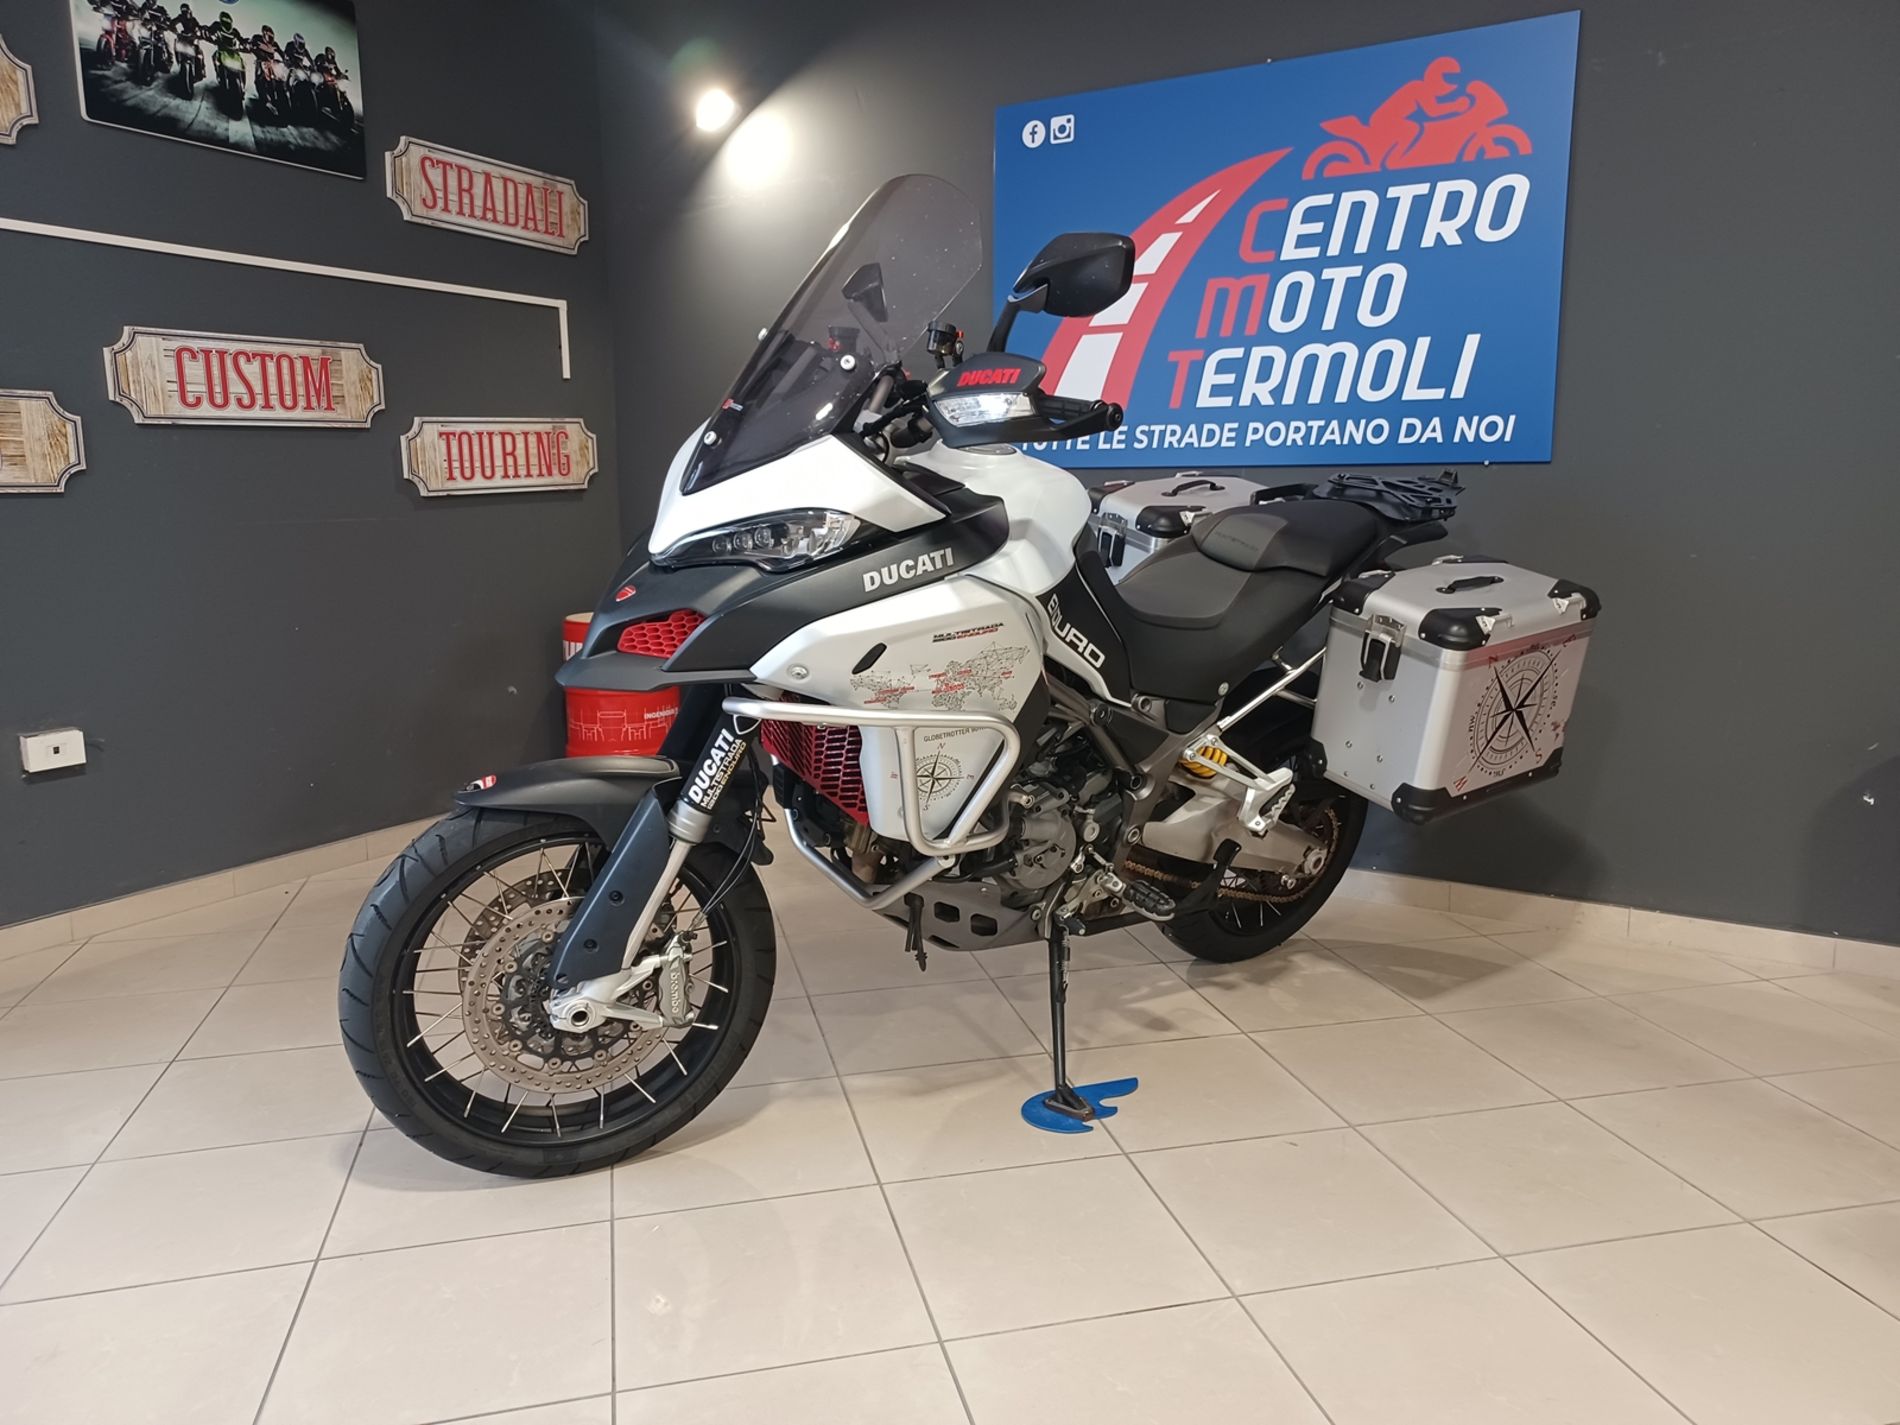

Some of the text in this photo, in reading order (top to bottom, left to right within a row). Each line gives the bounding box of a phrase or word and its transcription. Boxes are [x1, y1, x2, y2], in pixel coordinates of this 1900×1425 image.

[420, 156, 565, 238] STRADALI
[1239, 173, 1531, 263] CENTRO
[1195, 262, 1408, 339] MOTO
[175, 346, 337, 411] CUSTOM
[956, 367, 1021, 387] DUCATI
[1168, 333, 1481, 409] TERMOLI
[439, 430, 571, 480] TOURING
[1102, 424, 1127, 449] LE
[1134, 422, 1239, 450] STRADE
[1245, 418, 1390, 447] PORTANO
[1398, 416, 1444, 444] DA
[1453, 414, 1516, 443] NOI
[862, 547, 954, 593] DUCATI
[1047, 593, 1106, 668] EDURO
[688, 728, 735, 804] DUCATI
[720, 741, 747, 787] ENDURO
[923, 727, 970, 742] GLOBETROTTER
[700, 738, 743, 808] MULTISTRADA
[670, 972, 681, 1014] brembo
